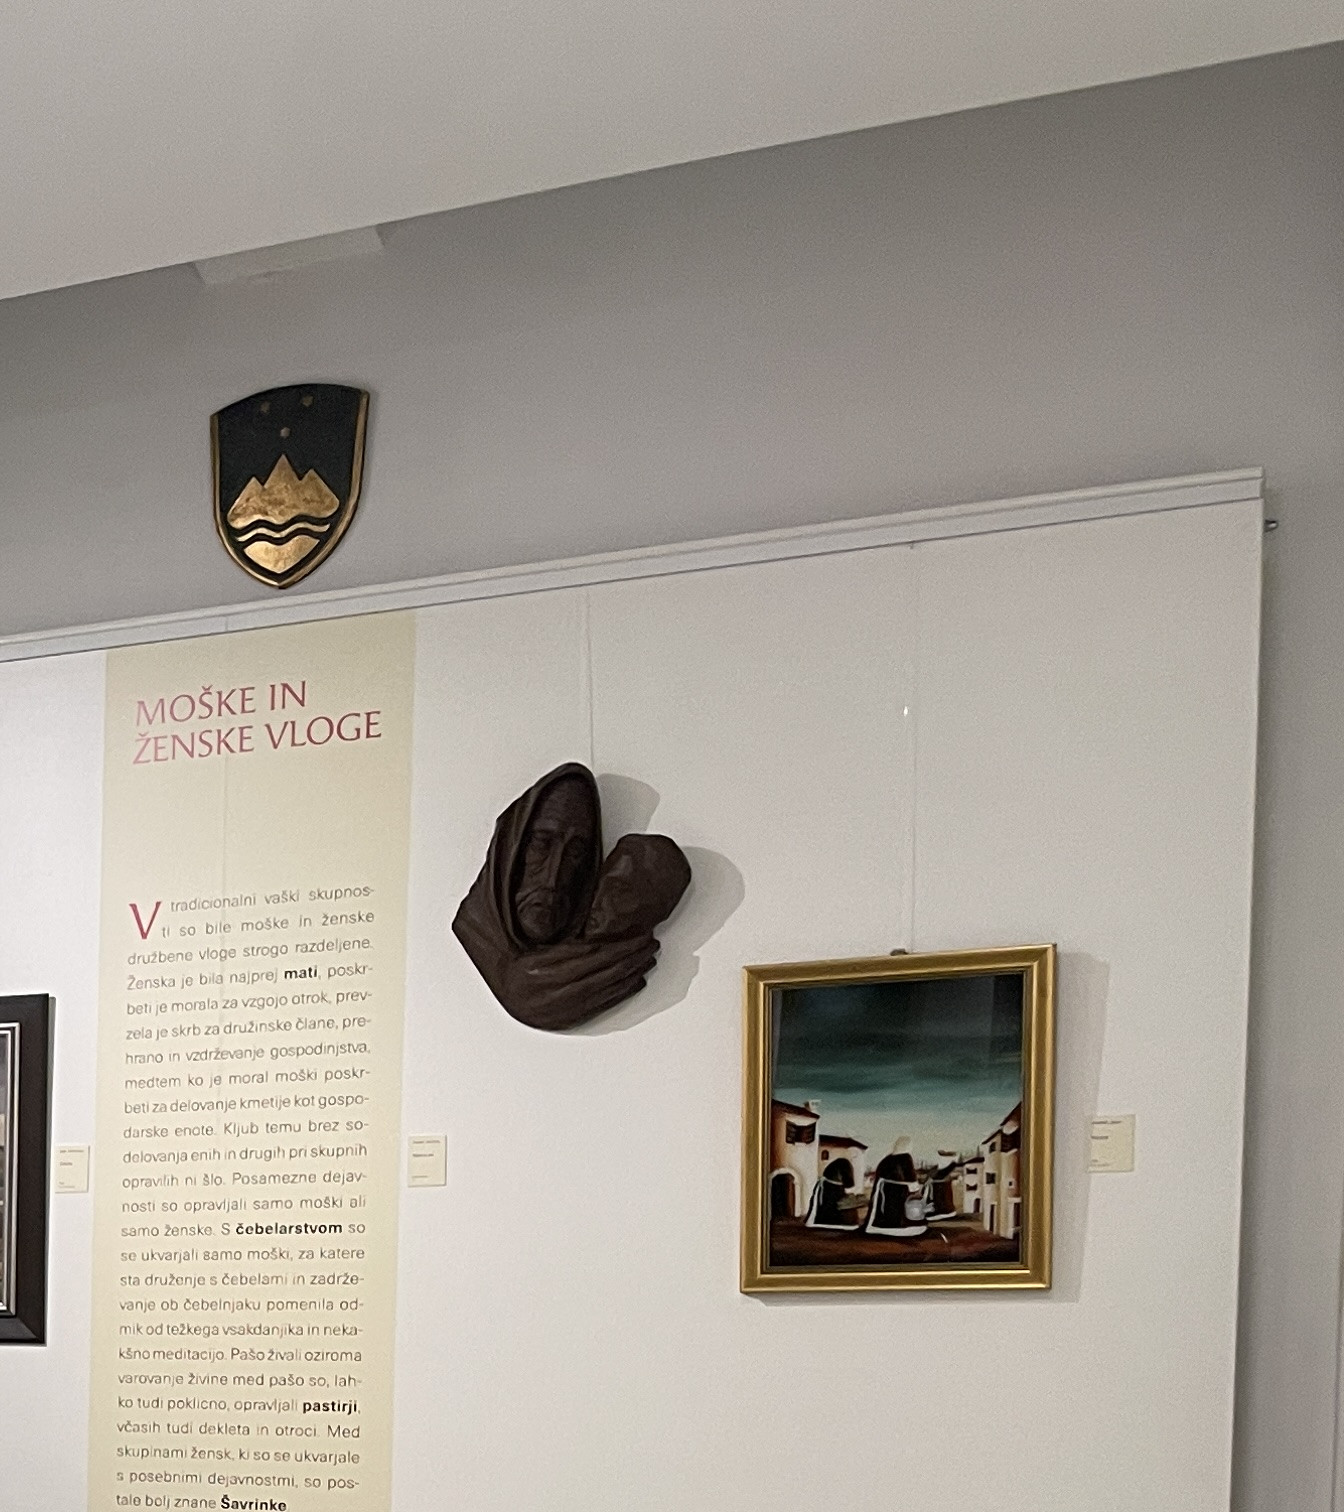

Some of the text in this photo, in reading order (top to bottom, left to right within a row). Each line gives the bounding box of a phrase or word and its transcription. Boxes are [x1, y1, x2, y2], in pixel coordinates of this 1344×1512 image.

[136, 680, 306, 726] MOŠKE IN
[133, 711, 382, 765] ŽENSKE VLOGE
[129, 885, 375, 940] V tradicionalni vaški skupnos-
[162, 926, 170, 939] ti
[180, 926, 196, 937] so
[205, 921, 231, 935] bile
[241, 916, 289, 932] moške
[321, 911, 374, 926] ženske
[128, 950, 193, 965] družbene
[199, 947, 236, 962] vloge
[243, 944, 289, 958] strogo
[127, 974, 176, 991] Ženska
[181, 975, 193, 989] je
[199, 973, 223, 985] bila
[230, 969, 278, 985] najprej
[327, 964, 373, 979] poskr-
[127, 1002, 152, 1015] beti
[155, 1001, 167, 1015] je
[171, 998, 218, 1012] morala
[222, 997, 238, 1009] za
[242, 994, 288, 1011] vzgojo
[336, 989, 373, 1004] prev-
[126, 1027, 152, 1041] zela
[156, 1027, 168, 1042] je
[172, 1024, 200, 1038] skrb
[204, 1024, 219, 1036] za
[223, 1020, 292, 1035] družinske
[342, 1014, 371, 1030] pre-
[126, 1052, 163, 1065] hrano
[186, 1046, 264, 1062] vzdrževanje
[125, 1067, 370, 1090] medtem ko je moral moški poskr-
[124, 1094, 369, 1114] beti za delovanje kmetije kot gospo-
[124, 1126, 169, 1139] darske
[223, 1122, 259, 1137] Kljub
[265, 1122, 301, 1134] temu
[308, 1120, 339, 1132] brez
[346, 1120, 369, 1132] so-
[123, 1151, 187, 1165] delovanja
[191, 1149, 220, 1162] enih
[239, 1147, 285, 1161] drugih
[289, 1146, 307, 1160] pri
[310, 1144, 367, 1161] skupnih
[122, 1176, 179, 1190] opravilih
[185, 1176, 196, 1186] ni
[232, 1172, 316, 1186] Posamezne
[323, 1169, 367, 1184] dejav-
[122, 1200, 155, 1213] nosti
[162, 1201, 177, 1213] so
[184, 1199, 246, 1214] opravljali
[253, 1199, 293, 1210] samo
[300, 1195, 343, 1209] moški
[121, 1226, 159, 1238] samo
[221, 1222, 230, 1235] S
[236, 1222, 343, 1235] čebelarstvom
[348, 1223, 365, 1234] so
[121, 1250, 137, 1262] se
[141, 1248, 198, 1263] ukvarjali
[203, 1248, 242, 1261] samo
[298, 1248, 314, 1260] za
[320, 1246, 364, 1260] katere
[120, 1275, 140, 1286] sta
[145, 1272, 205, 1288] druženje
[222, 1272, 288, 1286] čebelami
[310, 1272, 364, 1286] zadrže-
[120, 1297, 364, 1313] vanje ob čebelnjaku pomenila od-
[119, 1323, 143, 1336] mik
[146, 1324, 163, 1336] od
[167, 1323, 219, 1338] težkega
[324, 1323, 363, 1336] neka-
[119, 1347, 150, 1360] kšno
[231, 1348, 265, 1361] Pašo
[268, 1348, 301, 1361] živali
[305, 1350, 362, 1362] oziroma
[118, 1374, 183, 1387] varovanje
[188, 1373, 228, 1386] živine
[233, 1374, 264, 1386] med
[269, 1374, 304, 1389] pašo
[334, 1374, 362, 1388] lah-
[118, 1397, 133, 1409] ko
[137, 1397, 163, 1409] tudi
[234, 1399, 298, 1413] opravljali
[117, 1420, 160, 1434] včasih
[167, 1422, 193, 1435] tudi
[199, 1422, 250, 1436] dekleta
[327, 1425, 360, 1439] Med
[238, 1448, 250, 1460] ki
[254, 1449, 270, 1461] so
[274, 1450, 290, 1462] se
[294, 1450, 360, 1466] ukvarjale
[304, 1476, 321, 1488] so
[328, 1477, 359, 1491] pos-
[145, 1495, 170, 1510] bolj
[174, 1497, 216, 1510] znane
